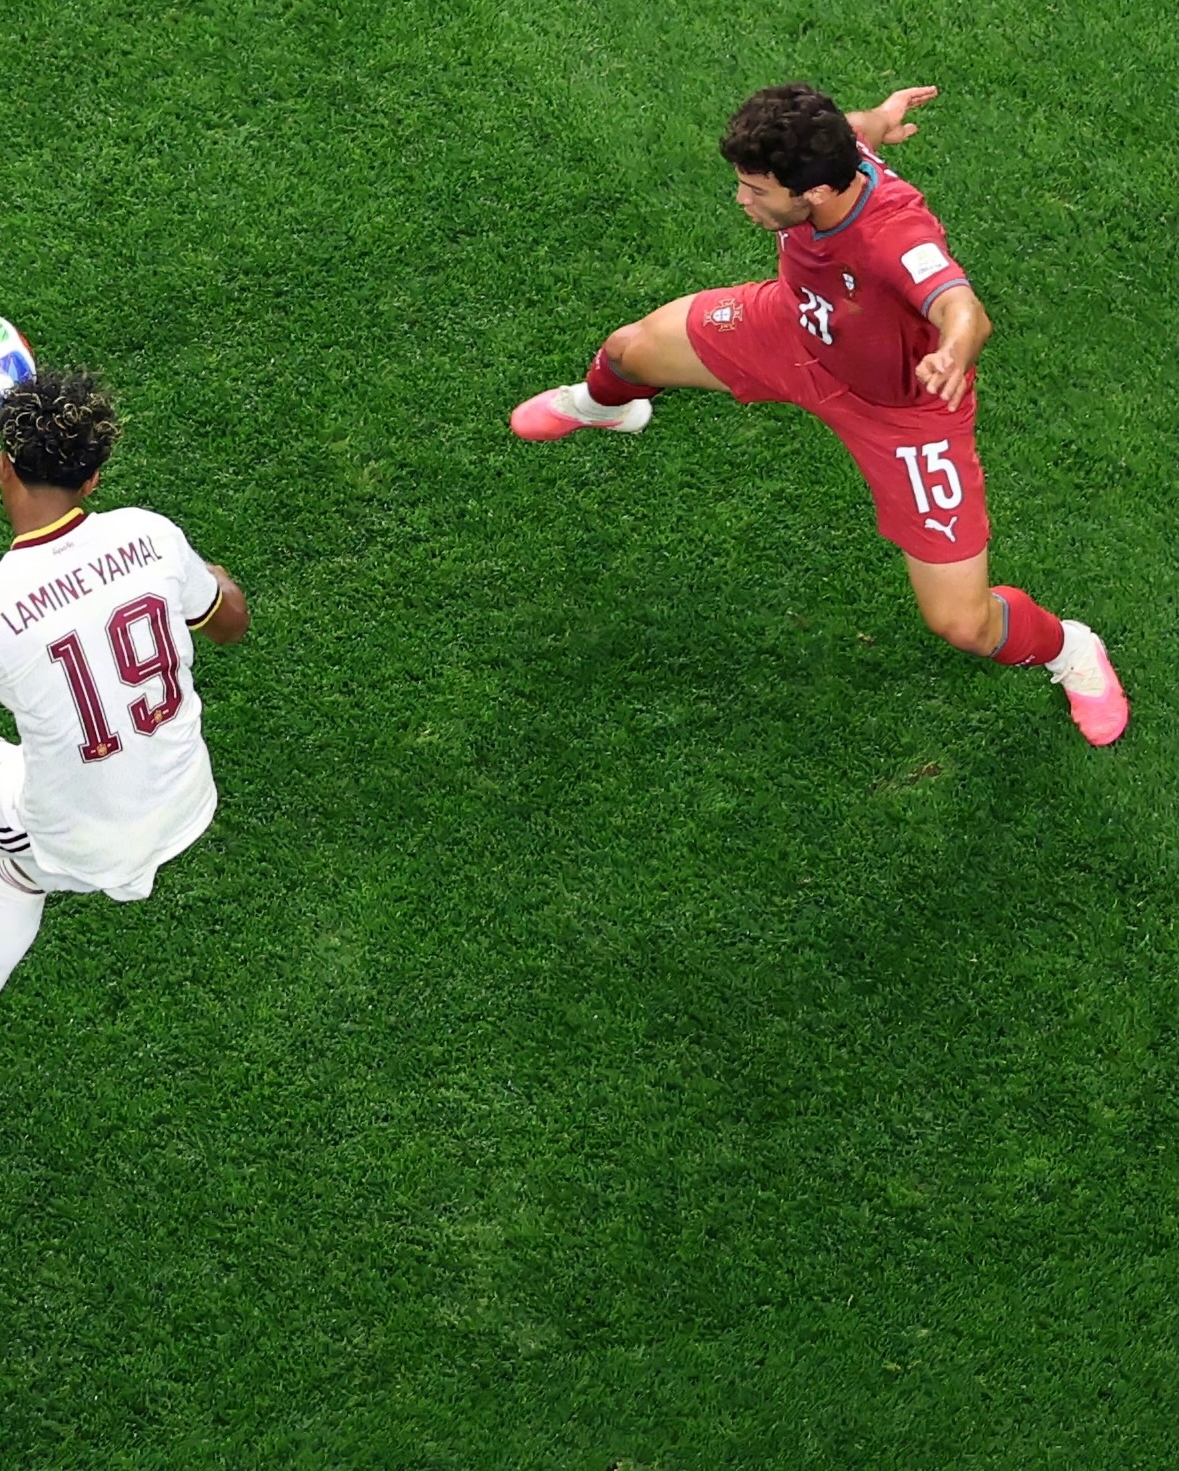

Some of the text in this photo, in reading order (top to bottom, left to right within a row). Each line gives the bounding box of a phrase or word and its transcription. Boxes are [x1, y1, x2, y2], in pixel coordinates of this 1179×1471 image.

[895, 439, 963, 514] 15
[0, 534, 163, 636] LAMINE YAMAL
[46, 591, 183, 764] 19
